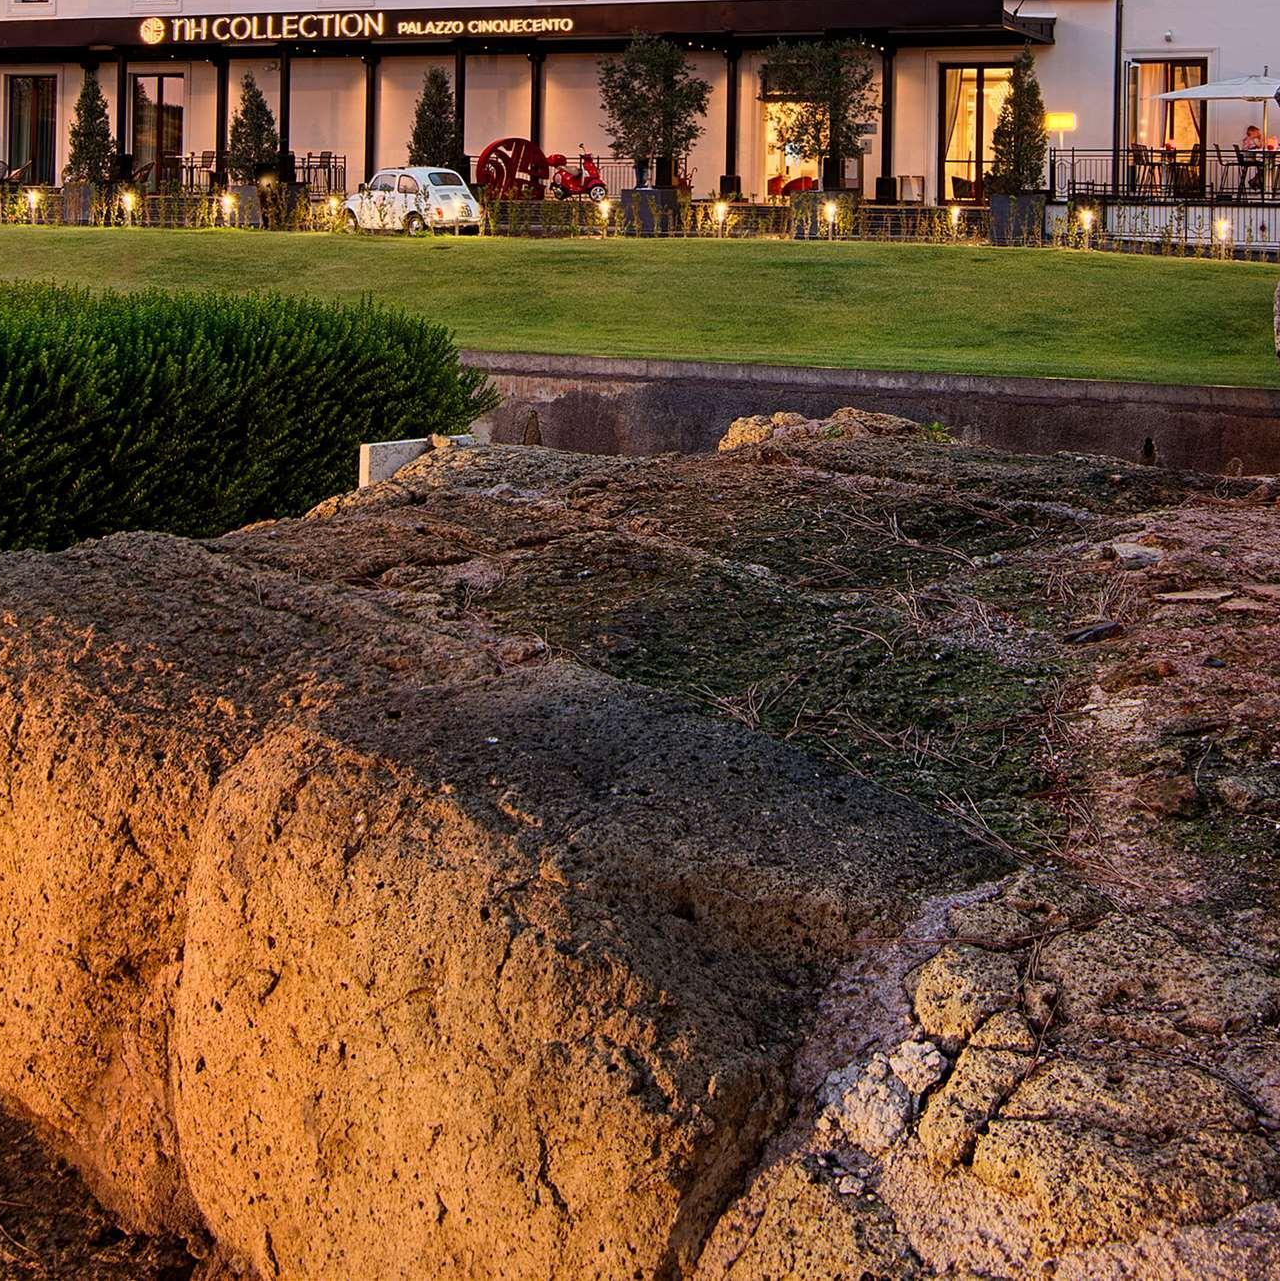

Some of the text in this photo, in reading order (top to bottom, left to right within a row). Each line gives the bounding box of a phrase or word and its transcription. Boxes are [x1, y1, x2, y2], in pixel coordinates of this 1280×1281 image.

[212, 12, 383, 40] COLLECTION
[397, 21, 464, 35] PALAZZO
[467, 18, 574, 34] CINQUECENTO
